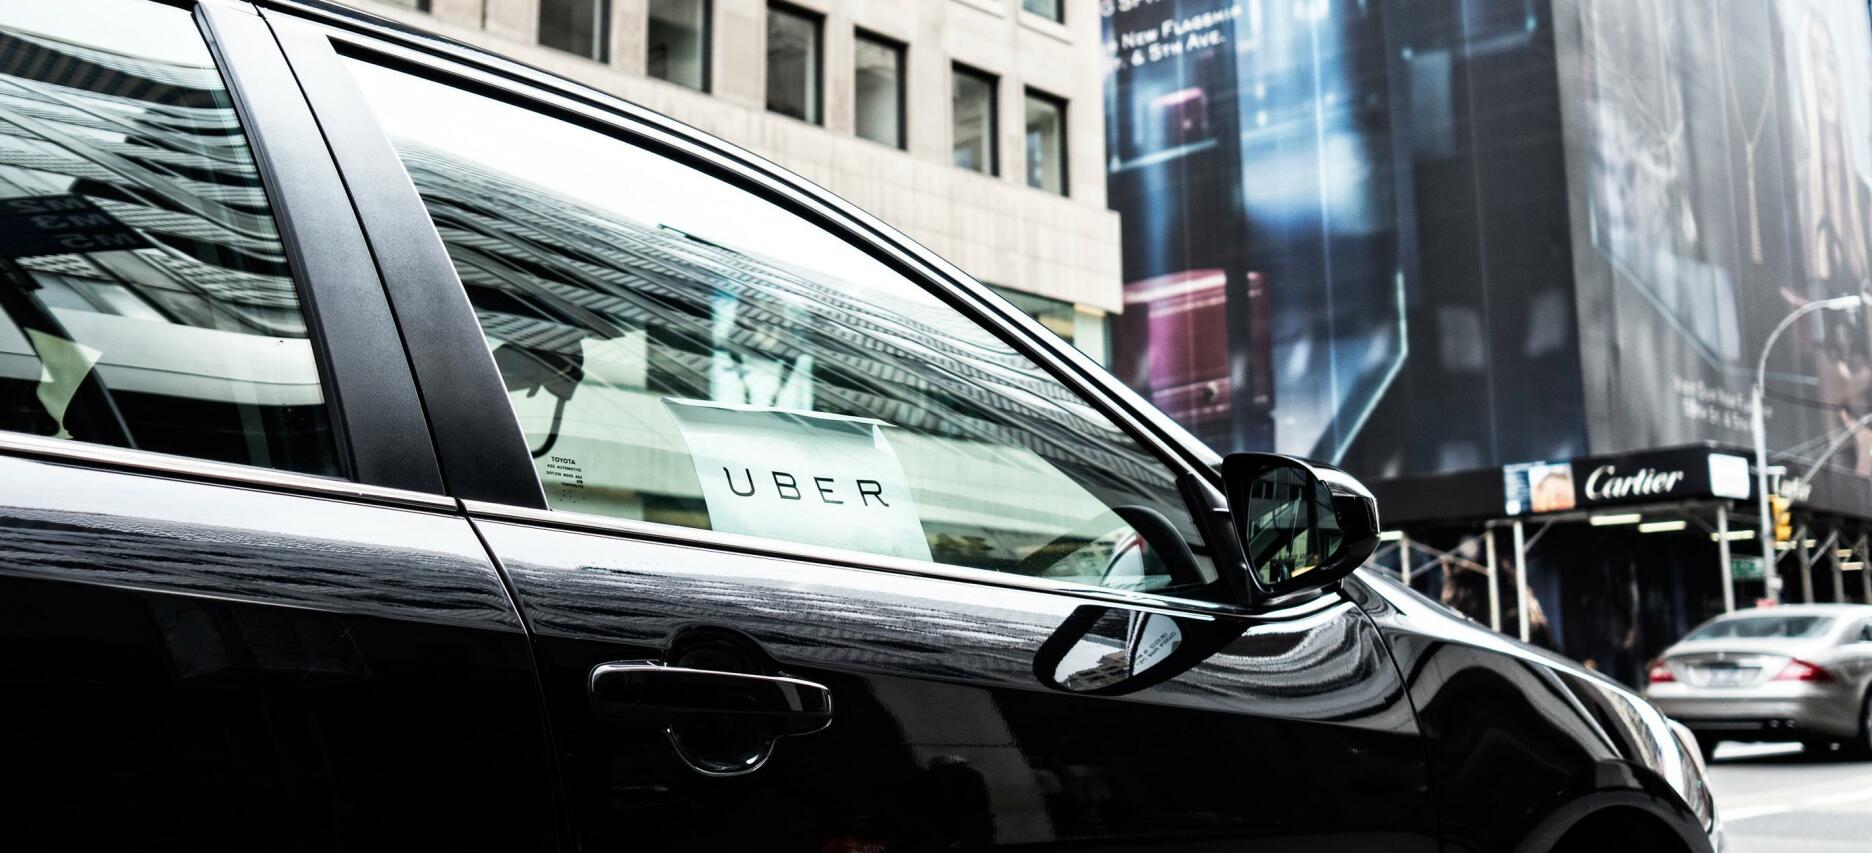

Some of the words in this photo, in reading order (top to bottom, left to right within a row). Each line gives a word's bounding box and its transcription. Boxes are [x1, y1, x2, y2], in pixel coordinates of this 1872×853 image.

[1131, 49, 1145, 66] &
[551, 456, 576, 465] TOYOTA
[723, 466, 890, 507] UBER
[1585, 465, 1684, 500] Cartier
